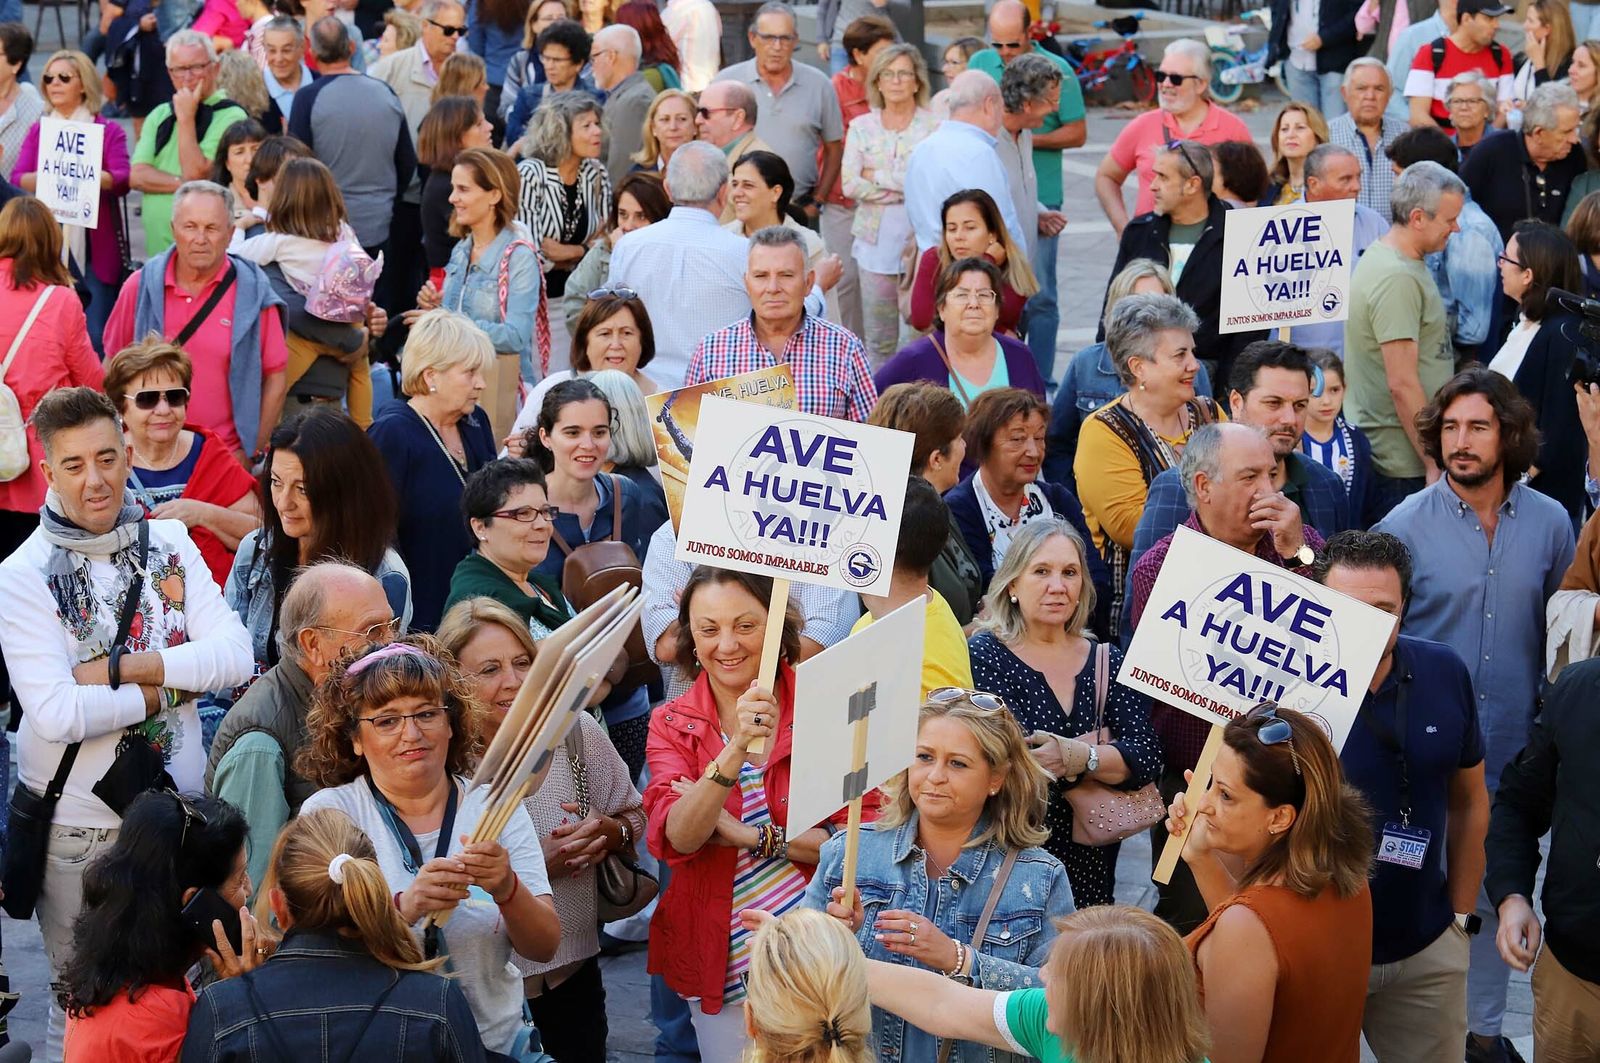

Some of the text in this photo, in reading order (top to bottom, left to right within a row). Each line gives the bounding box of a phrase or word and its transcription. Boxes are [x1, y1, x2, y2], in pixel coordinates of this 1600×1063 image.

[55, 130, 85, 155] AVE
[43, 159, 95, 180] A HUELVA
[1258, 215, 1322, 247] AVE
[1233, 249, 1343, 277] A HUELVA
[1263, 279, 1311, 302] YA!!!
[1226, 308, 1313, 326] JUNTOS SOMOS IMPARABLES
[739, 374, 791, 399] HUELVA
[749, 425, 858, 476] AVE
[703, 465, 730, 492] A
[743, 470, 888, 521] HUELVA
[752, 510, 831, 548] YA!!!
[686, 540, 726, 558] JUNTOS
[727, 547, 764, 565] SOMOS
[763, 554, 829, 576] IMPARABLES
[1214, 572, 1333, 644] AVE
[1161, 599, 1188, 629] A
[1200, 612, 1348, 698] HUELVA
[1129, 666, 1171, 692] JUNTOS
[1170, 684, 1209, 708] SOMOS
[1205, 653, 1286, 703] YA!!!
[1399, 840, 1425, 855] STAFF
